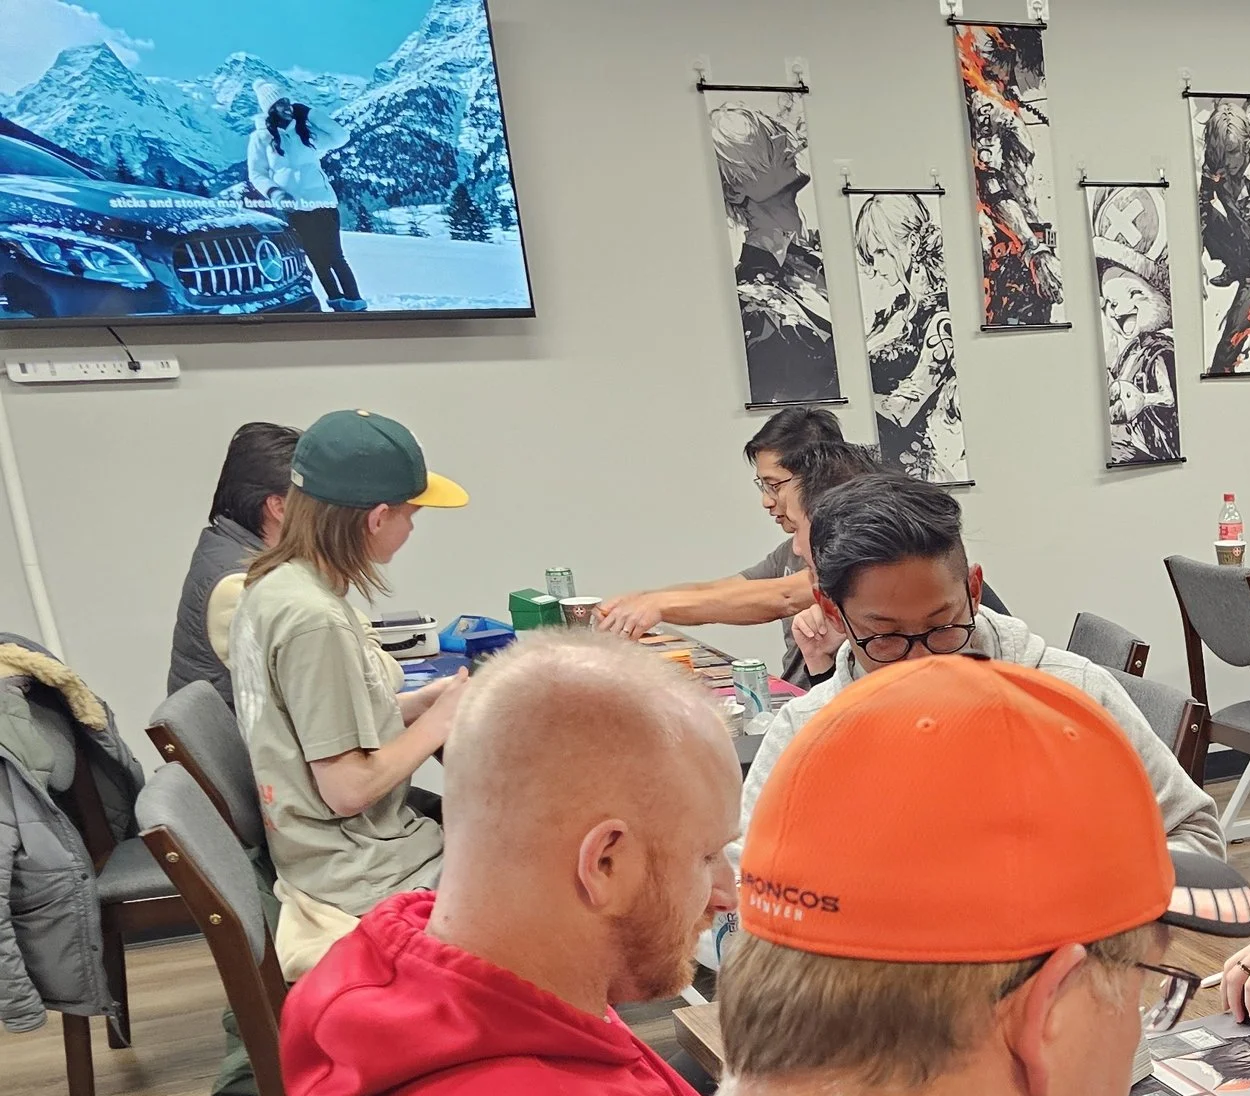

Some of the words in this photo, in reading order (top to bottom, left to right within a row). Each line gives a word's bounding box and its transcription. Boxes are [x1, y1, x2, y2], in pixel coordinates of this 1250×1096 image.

[109, 198, 147, 209] sticks
[150, 198, 173, 209] and
[175, 198, 215, 209] stones
[217, 199, 242, 211] may
[281, 199, 298, 211] my
[741, 869, 840, 913] RONCOS
